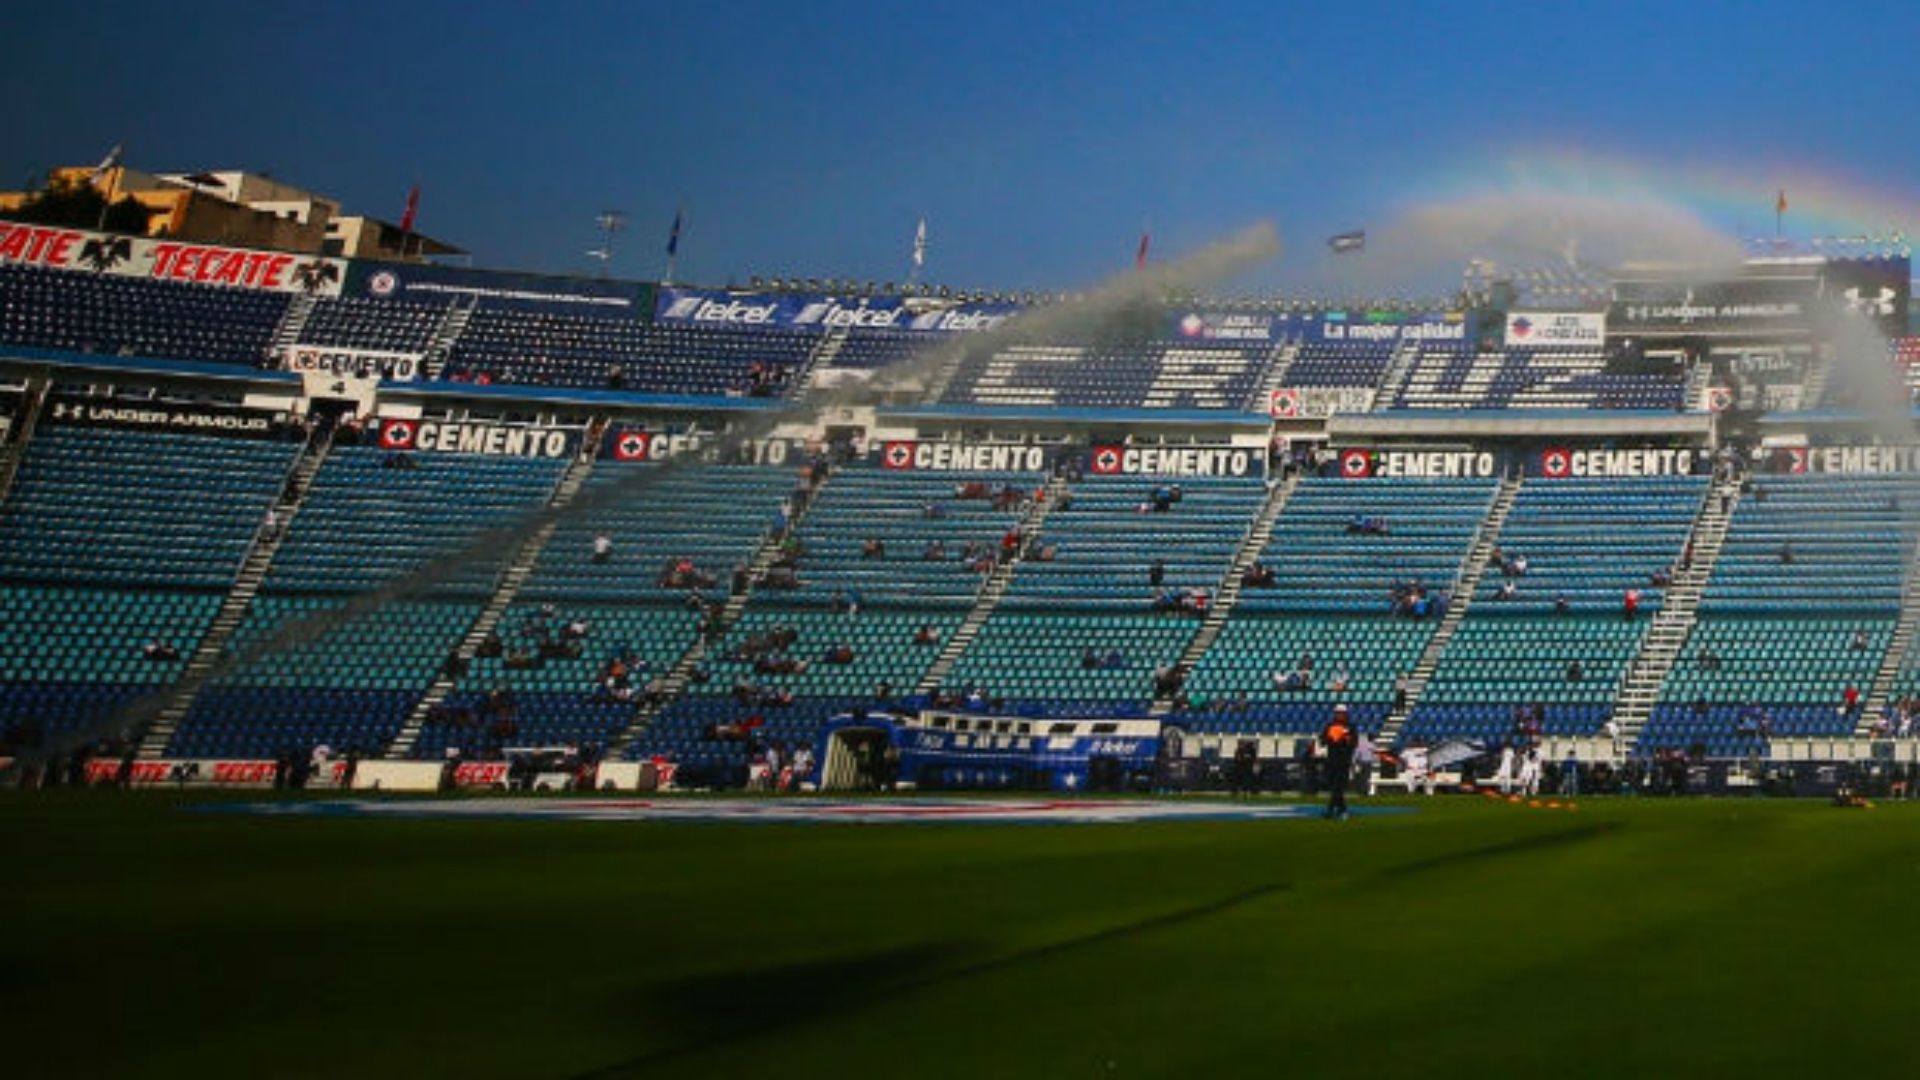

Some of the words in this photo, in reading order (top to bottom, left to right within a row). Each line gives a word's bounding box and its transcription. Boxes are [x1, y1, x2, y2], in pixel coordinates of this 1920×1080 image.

[0, 223, 84, 267] ATE
[152, 243, 294, 287] TECATE
[695, 298, 776, 324] telcel
[823, 300, 902, 327] telcel
[1323, 322, 1345, 339] La
[1401, 320, 1466, 339] calidad
[89, 408, 169, 425] UNDER
[170, 412, 268, 429] ARMOUR
[415, 422, 566, 458] CEMENTO
[648, 433, 787, 465] CETO
[914, 444, 1043, 471] CEMENTO
[1122, 448, 1248, 476] CEMENTO
[1570, 453, 1691, 477] CEMENTO
